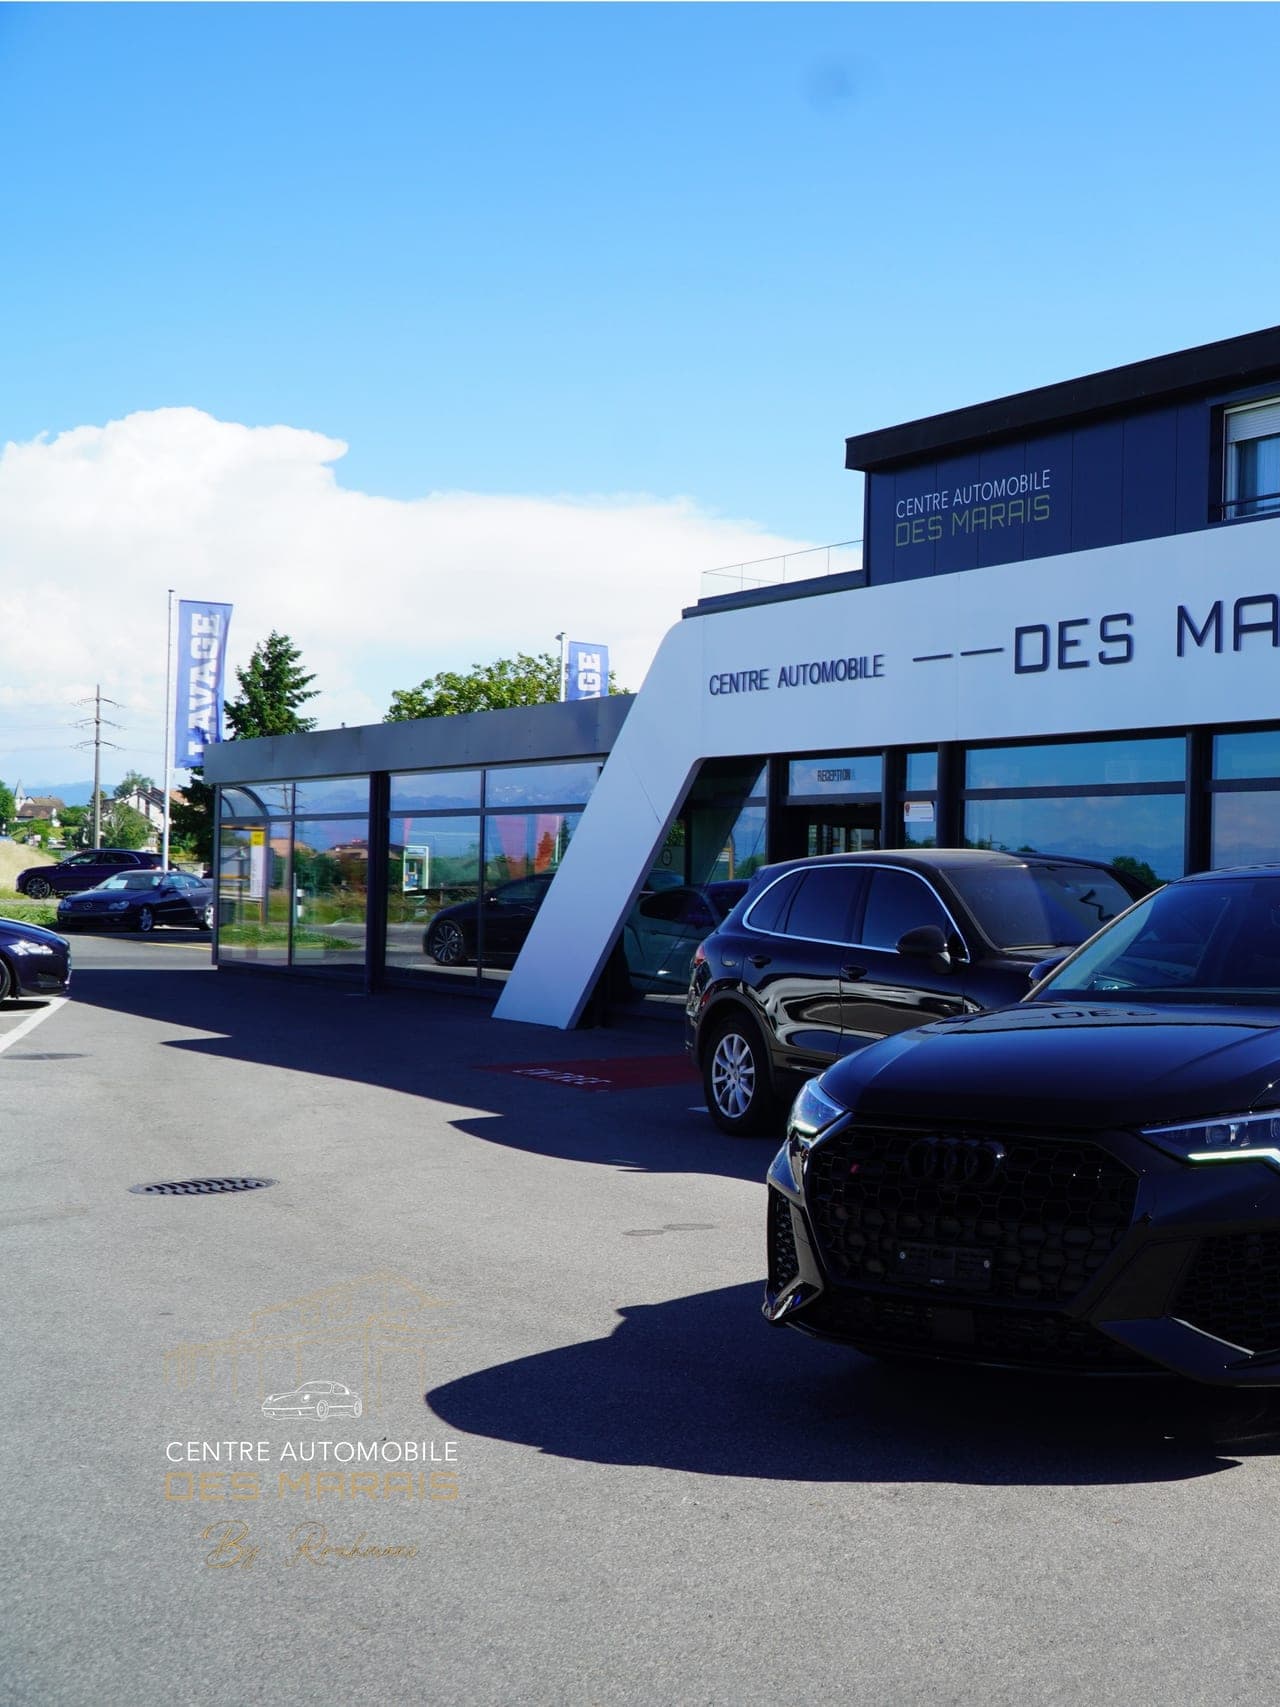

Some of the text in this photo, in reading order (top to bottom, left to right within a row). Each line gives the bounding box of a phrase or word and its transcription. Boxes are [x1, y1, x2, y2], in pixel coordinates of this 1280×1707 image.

[895, 494, 1050, 547] DES MARAIS
[896, 469, 1051, 519] CENTRE AUTOMOBILE
[709, 668, 770, 696] CENTRE
[777, 654, 886, 689] AUTOMOBILE
[1014, 612, 1134, 675] DES
